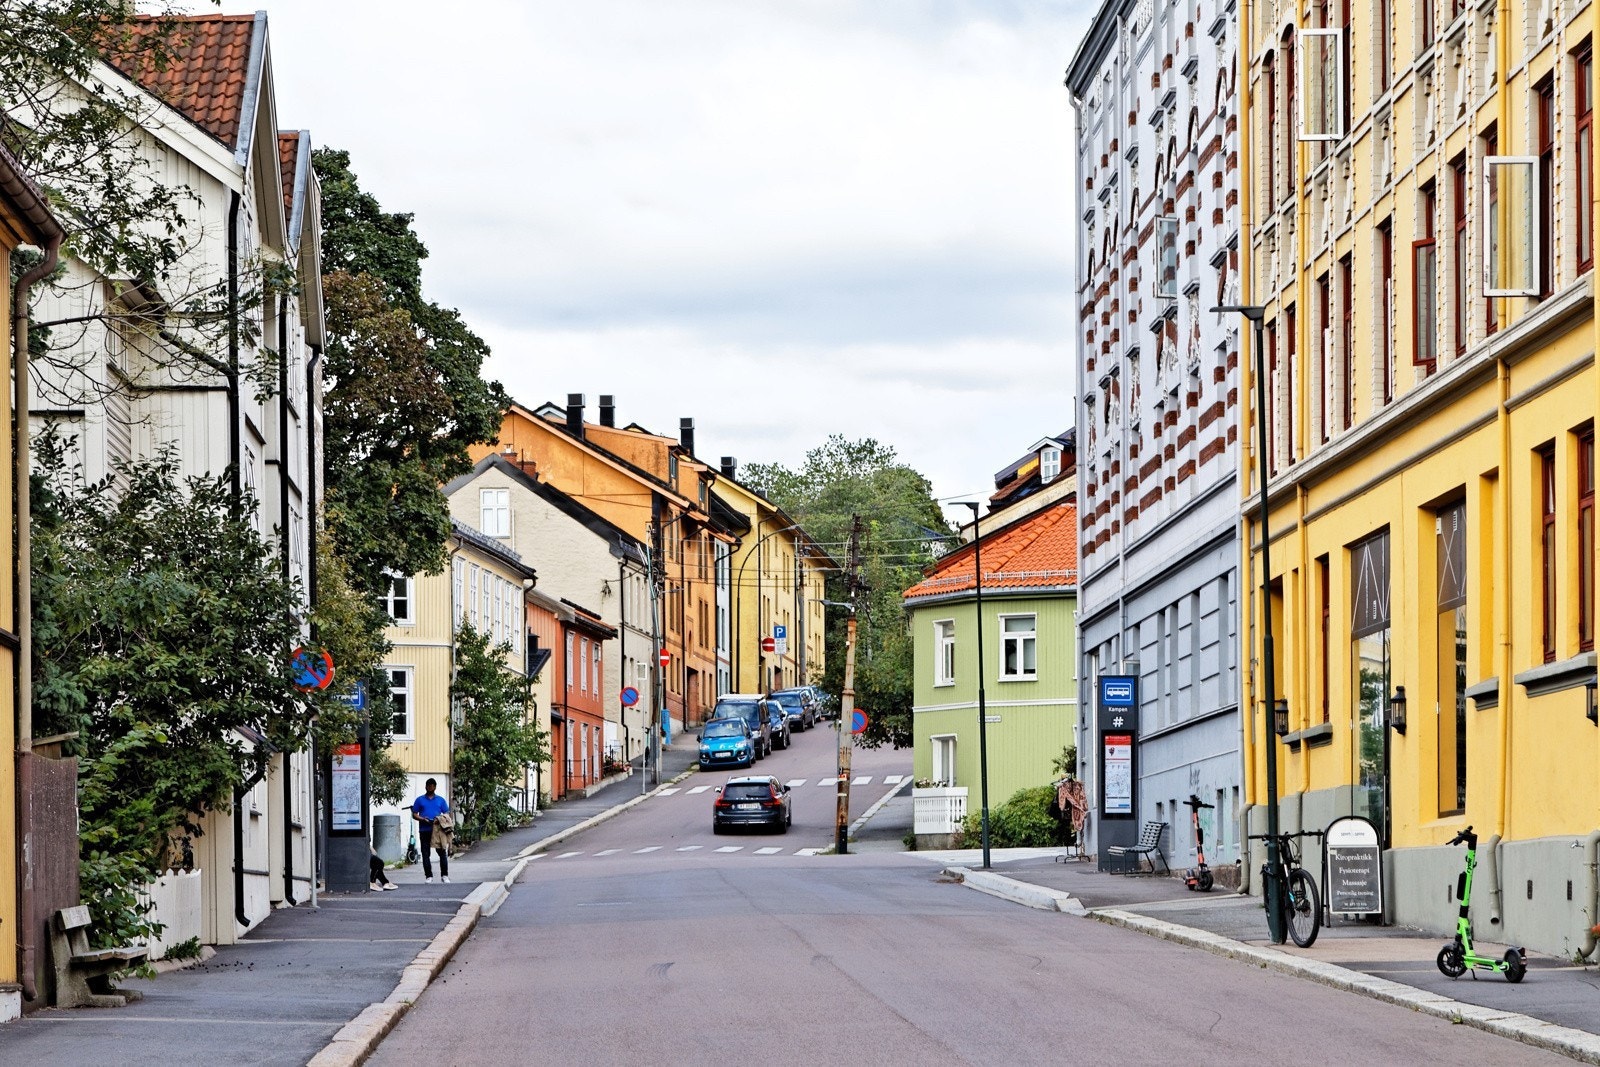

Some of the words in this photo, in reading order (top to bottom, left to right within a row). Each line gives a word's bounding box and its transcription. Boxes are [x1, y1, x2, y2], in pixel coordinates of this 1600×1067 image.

[776, 627, 783, 637] P
[1335, 853, 1373, 862] Kiropraktikk
[1338, 866, 1370, 875] Fysioterapi
